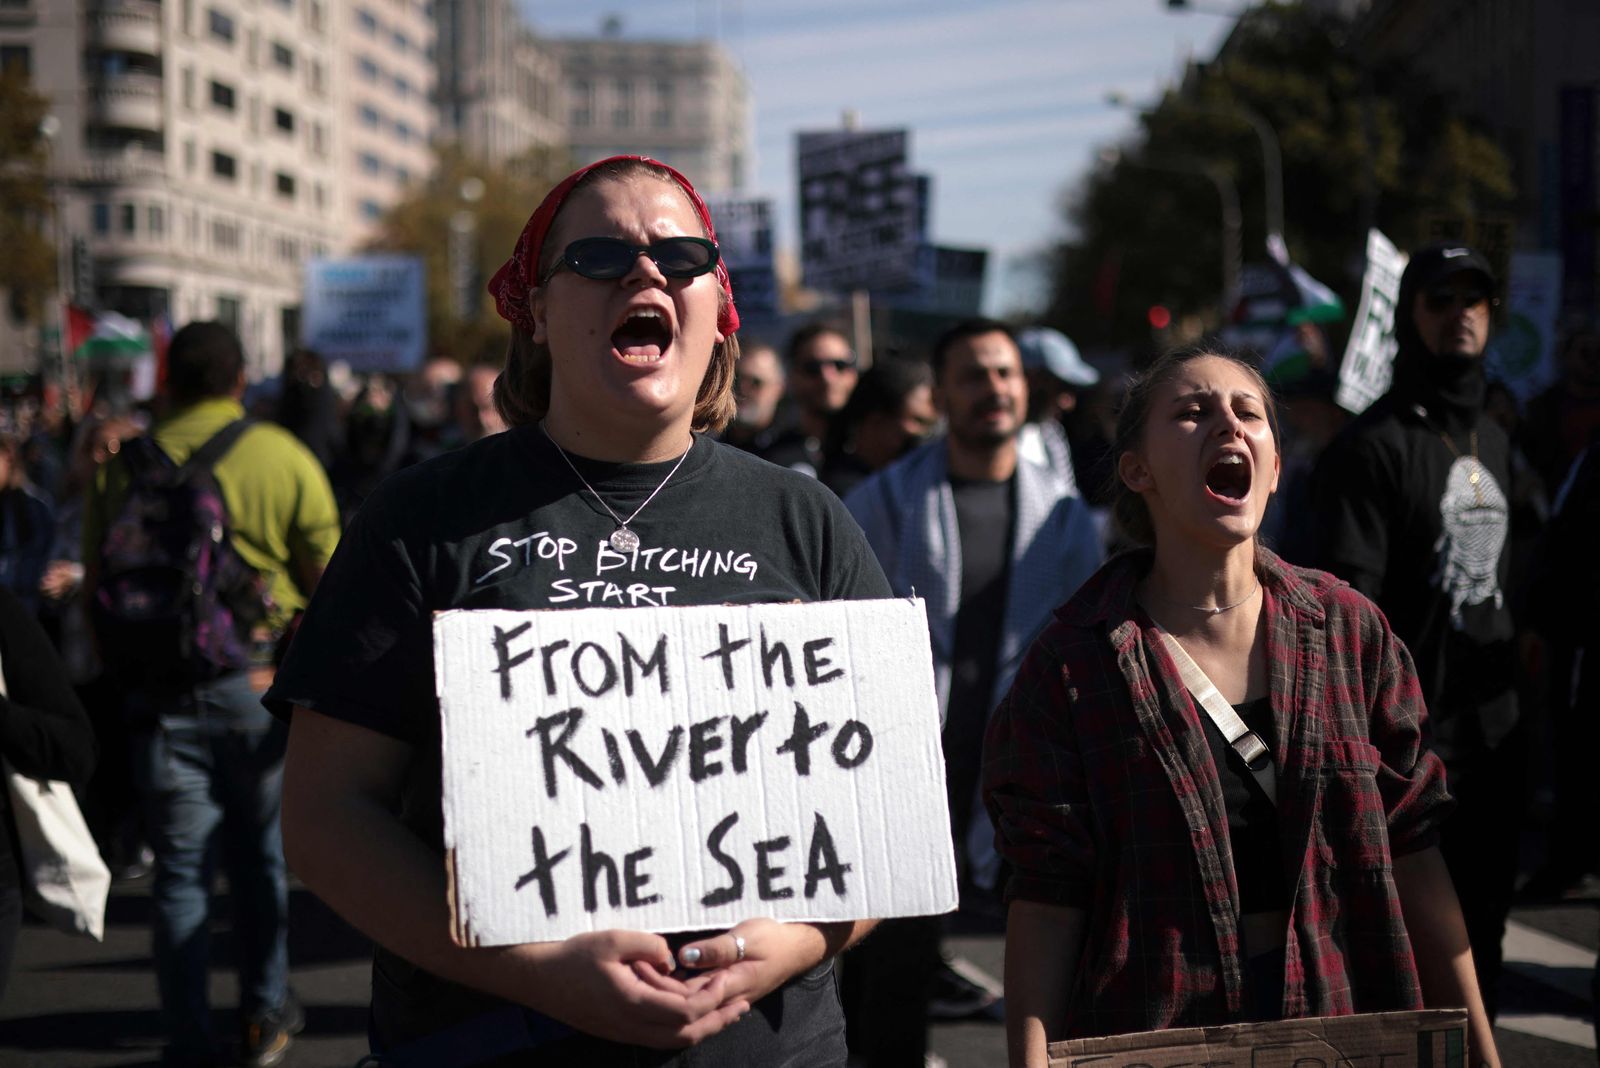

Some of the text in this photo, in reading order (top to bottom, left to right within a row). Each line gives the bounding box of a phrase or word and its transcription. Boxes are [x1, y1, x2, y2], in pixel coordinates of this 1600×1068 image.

[476, 531, 757, 583] STOP BITCHING
[549, 579, 676, 606] START
[776, 700, 873, 775] to
[701, 811, 852, 907] SEA
